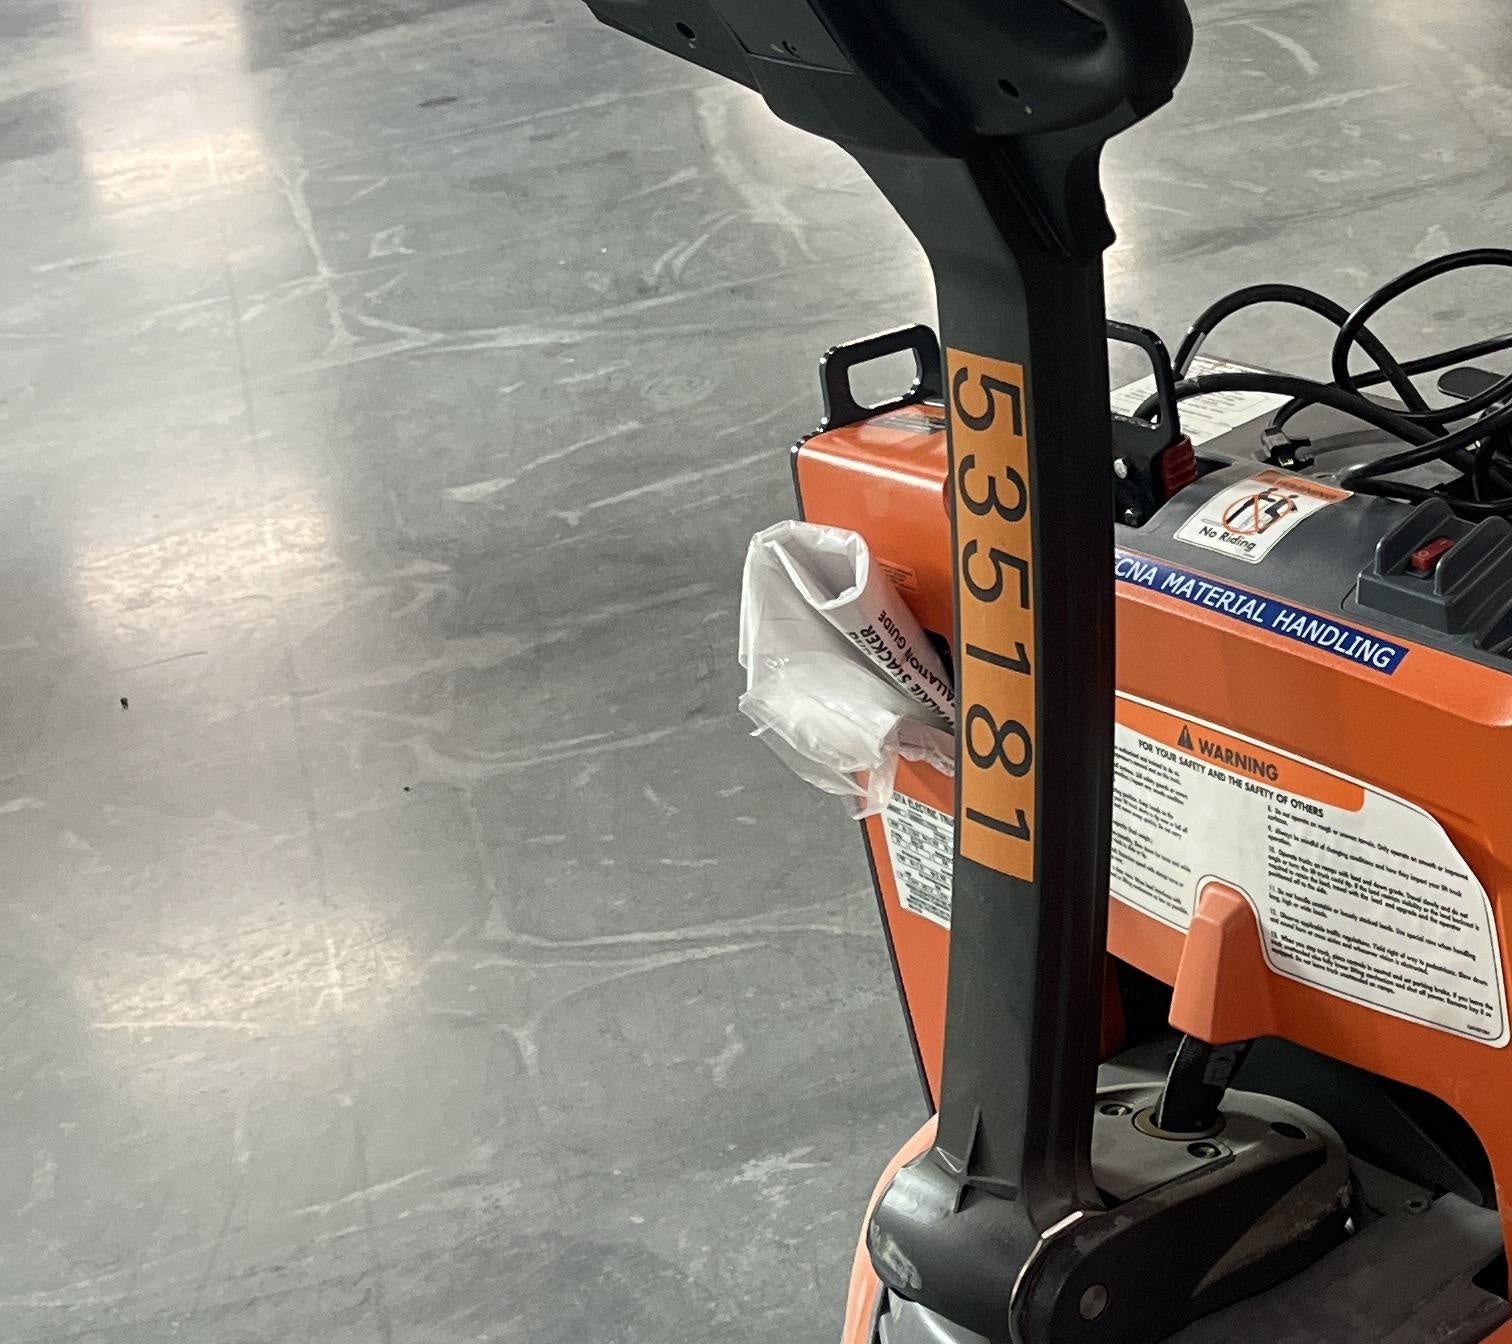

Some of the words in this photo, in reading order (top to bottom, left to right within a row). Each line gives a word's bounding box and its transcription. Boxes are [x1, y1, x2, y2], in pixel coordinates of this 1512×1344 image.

[1198, 525, 1217, 539] No
[1220, 531, 1257, 553] Riding
[877, 609, 906, 650] GUIDE
[951, 365, 1034, 843] 535181
[1115, 554, 1158, 586] CNA
[1161, 571, 1265, 623] MATERIAL
[1273, 609, 1396, 669] HANDLING
[903, 647, 956, 708] ALLATION
[1138, 738, 1154, 754] FOR
[1155, 745, 1177, 764] YOUR
[1178, 756, 1206, 776] SAFETY
[1207, 767, 1227, 783] AND
[1228, 774, 1243, 789] THE
[1244, 782, 1275, 801] SAFETY
[1276, 792, 1289, 804] OF
[1290, 798, 1325, 819] OTHERS
[1198, 737, 1280, 782] WARNING
